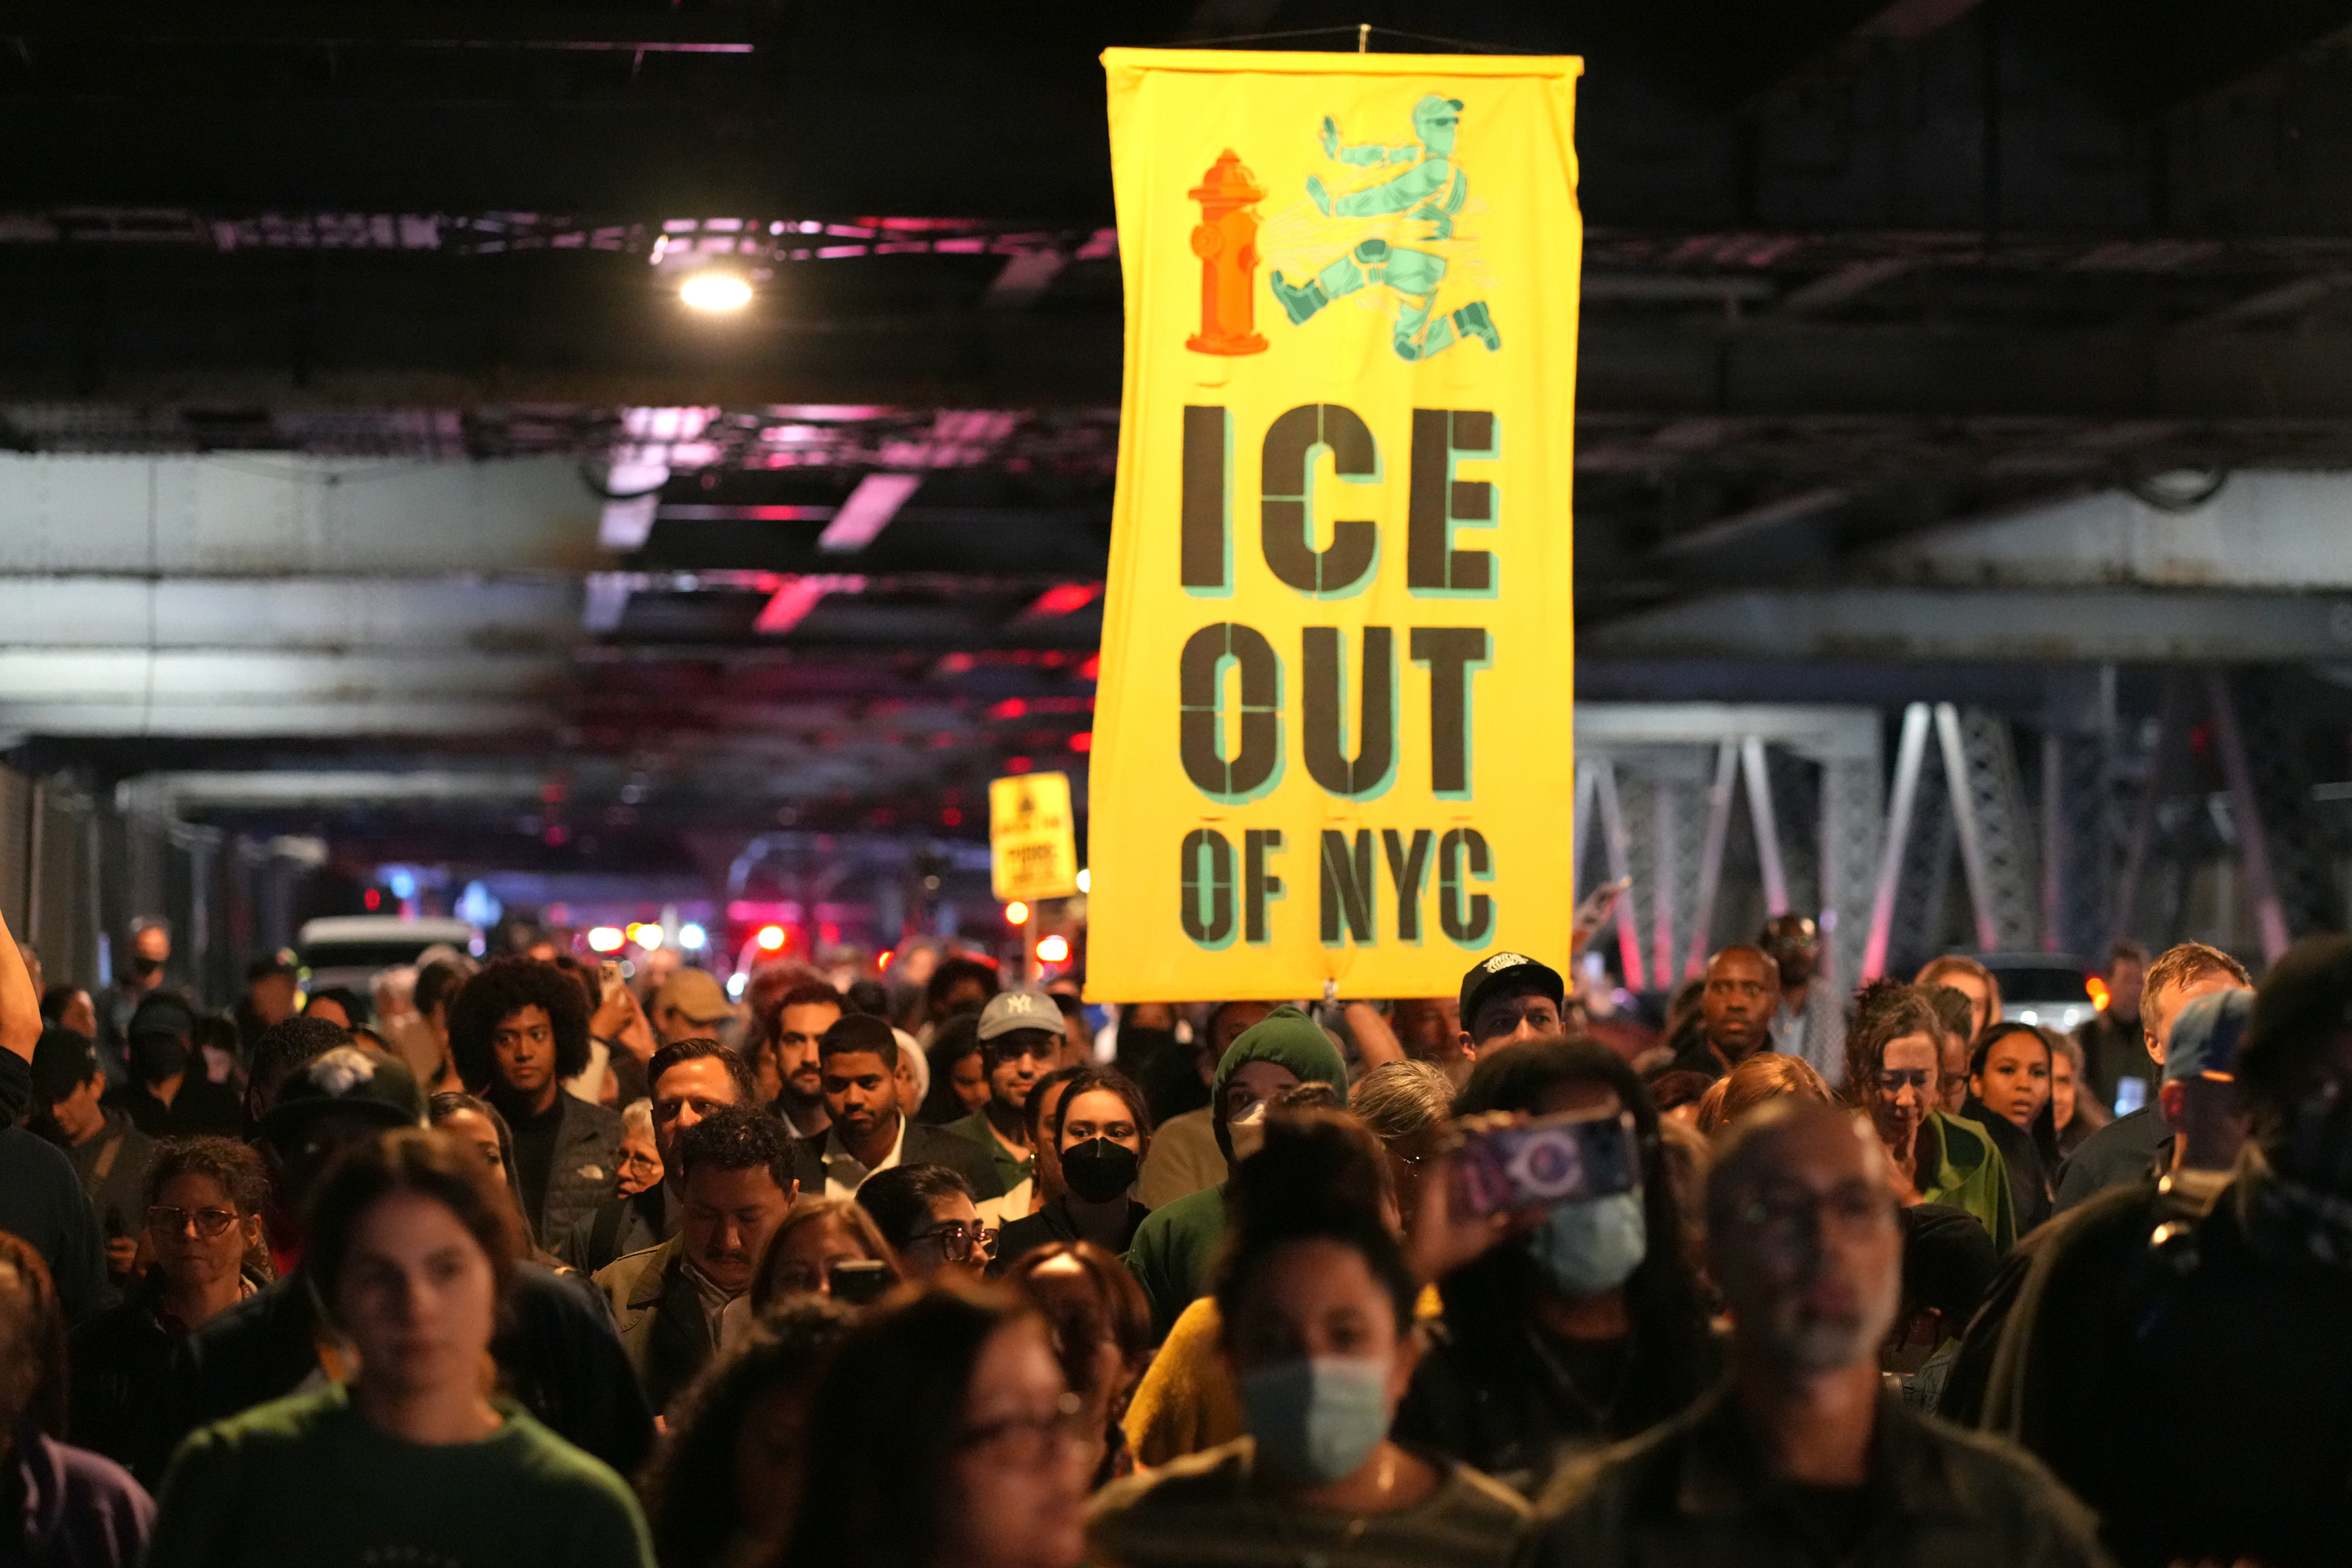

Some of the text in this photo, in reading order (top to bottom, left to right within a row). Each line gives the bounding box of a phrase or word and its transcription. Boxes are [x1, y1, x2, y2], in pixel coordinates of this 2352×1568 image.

[1181, 403, 1500, 600] ICE
[1179, 621, 1494, 805] OUT
[1180, 827, 1496, 951] OF NYC
